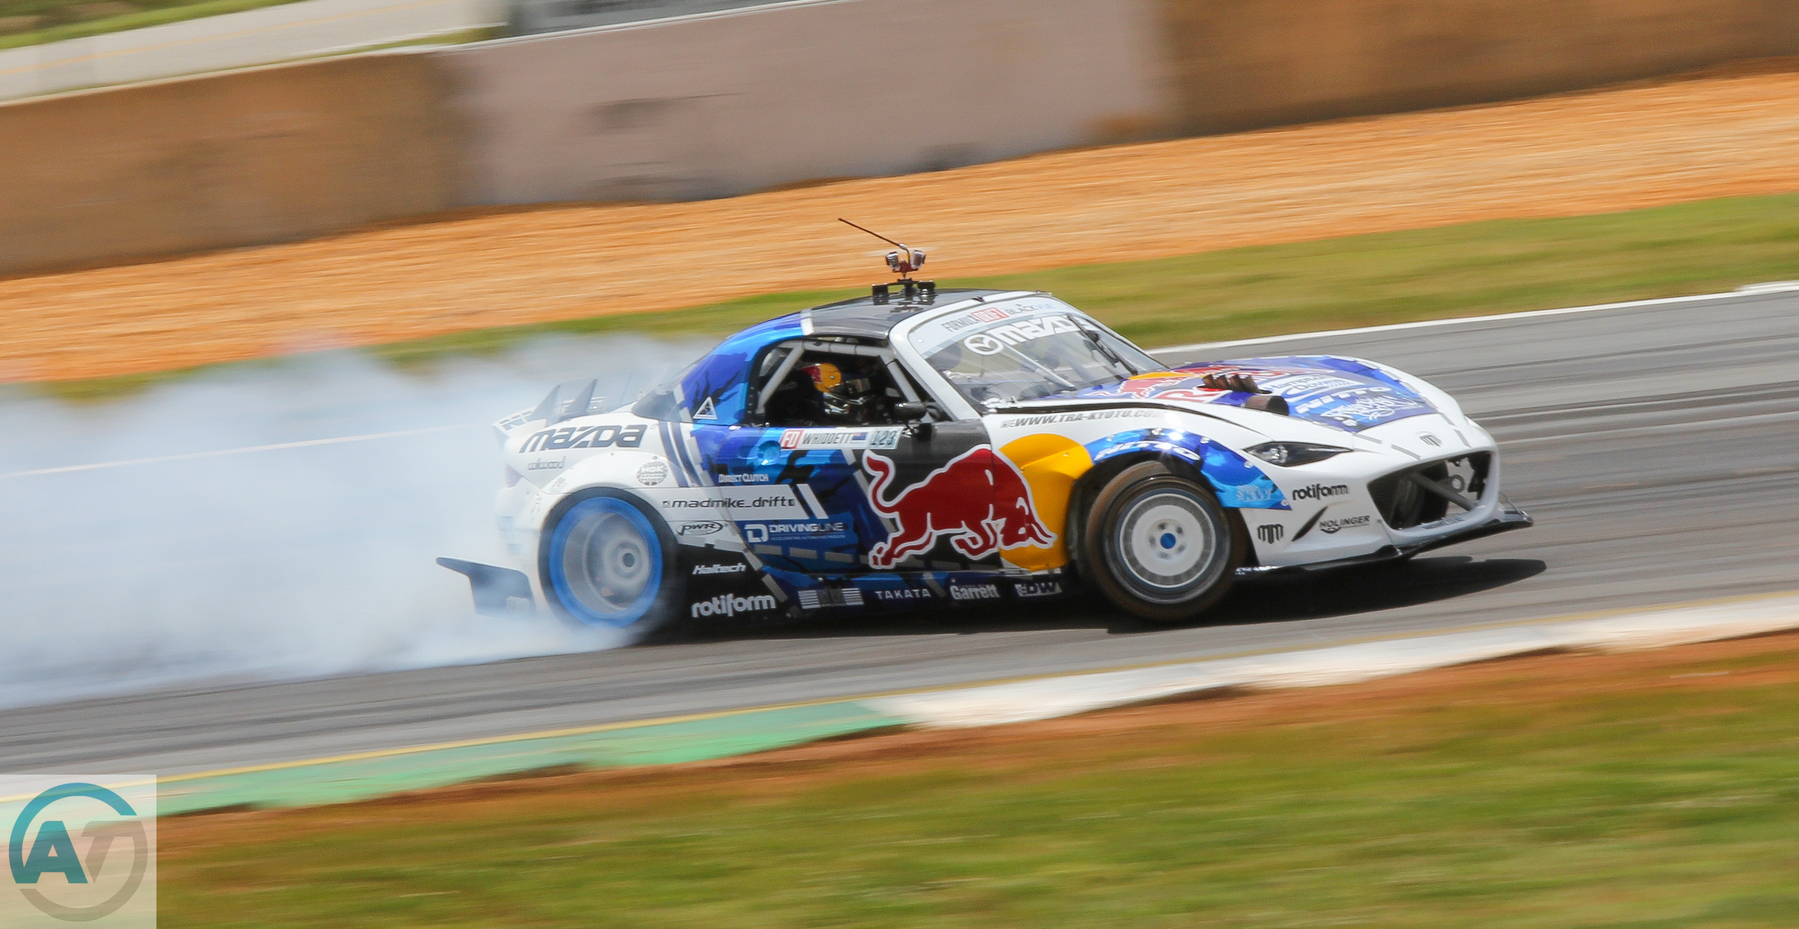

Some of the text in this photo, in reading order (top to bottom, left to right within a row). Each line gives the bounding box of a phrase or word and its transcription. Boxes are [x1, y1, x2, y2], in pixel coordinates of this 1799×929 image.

[1295, 386, 1392, 413] NITTO
[870, 430, 897, 446] 123
[1093, 440, 1201, 461] NITTO
[1319, 515, 1370, 528] HOLINGER
[692, 562, 746, 575] Haltech
[875, 588, 932, 600] TAKATA
[950, 584, 1000, 600] Garrett
[691, 593, 777, 618] rotiform
